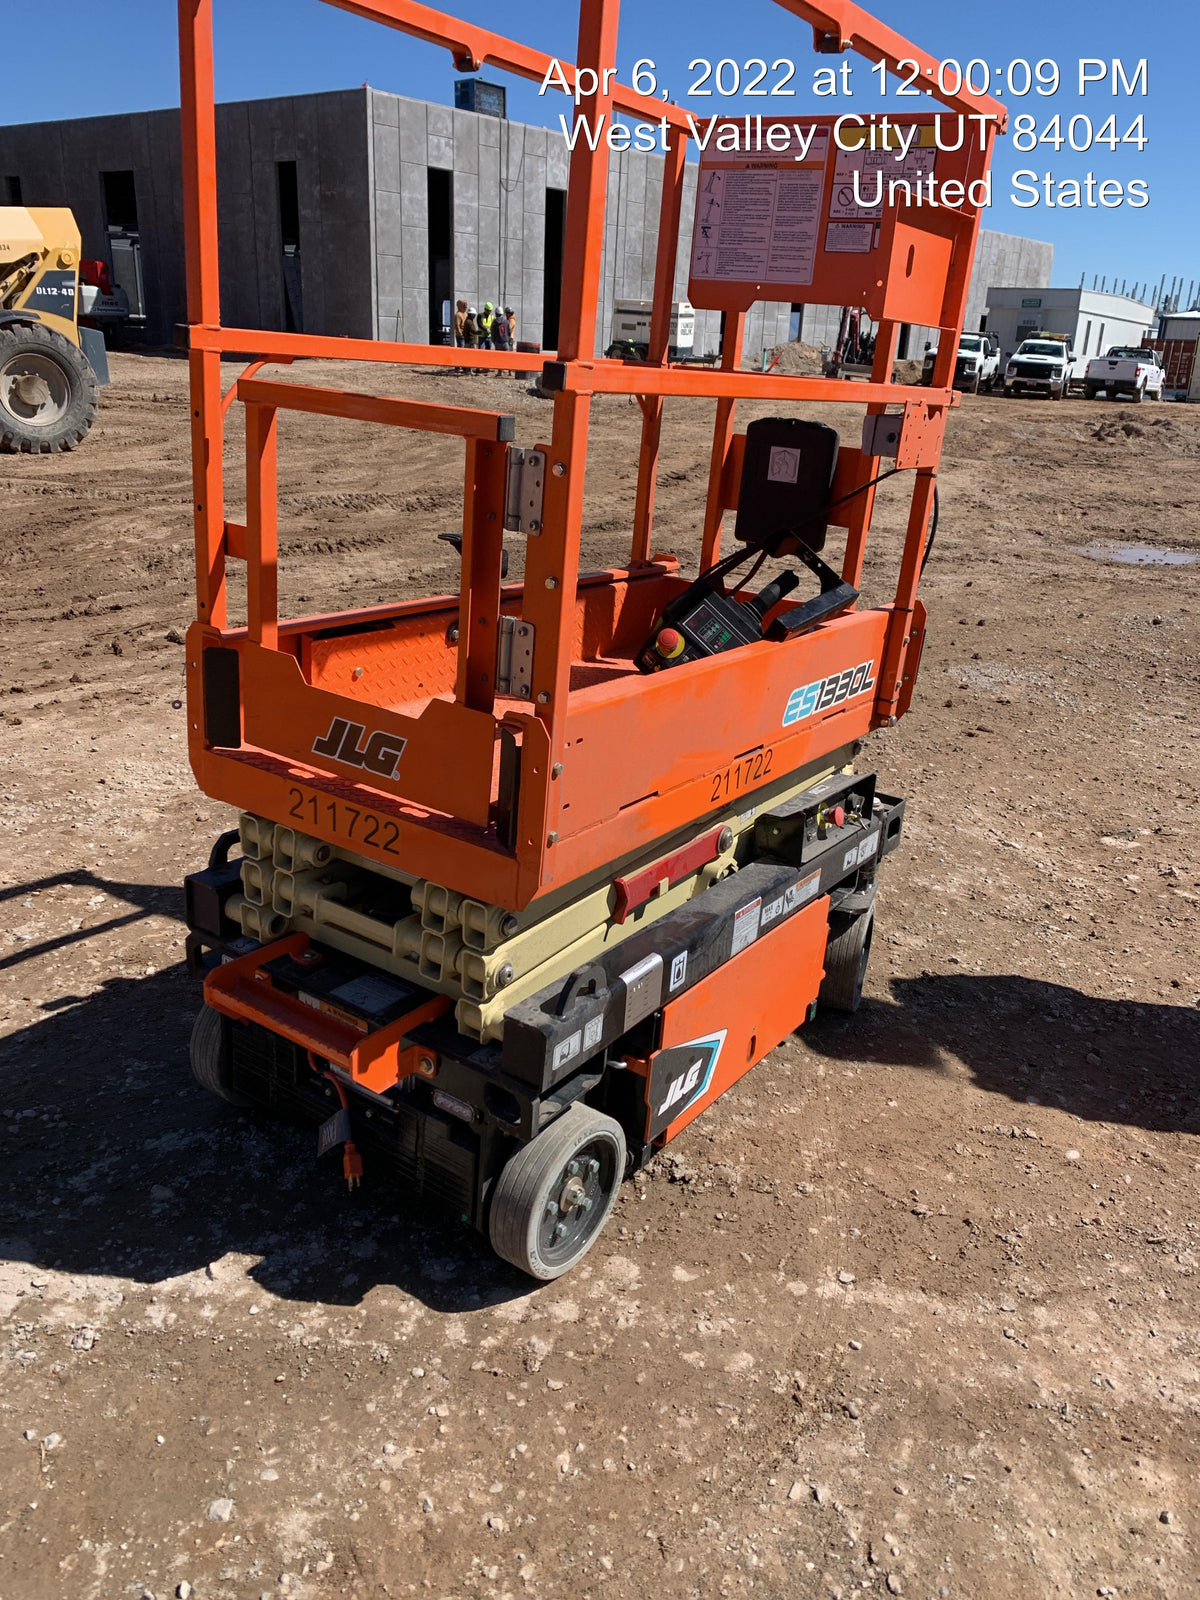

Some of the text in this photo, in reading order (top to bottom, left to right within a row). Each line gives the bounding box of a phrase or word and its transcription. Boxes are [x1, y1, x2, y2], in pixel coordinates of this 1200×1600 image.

[36, 286, 75, 296] DL12-40
[782, 659, 876, 727] ES1330L
[311, 715, 408, 780] JLG
[710, 748, 774, 803] 211722
[288, 787, 400, 855] 211722
[657, 1057, 703, 1117] JLG
